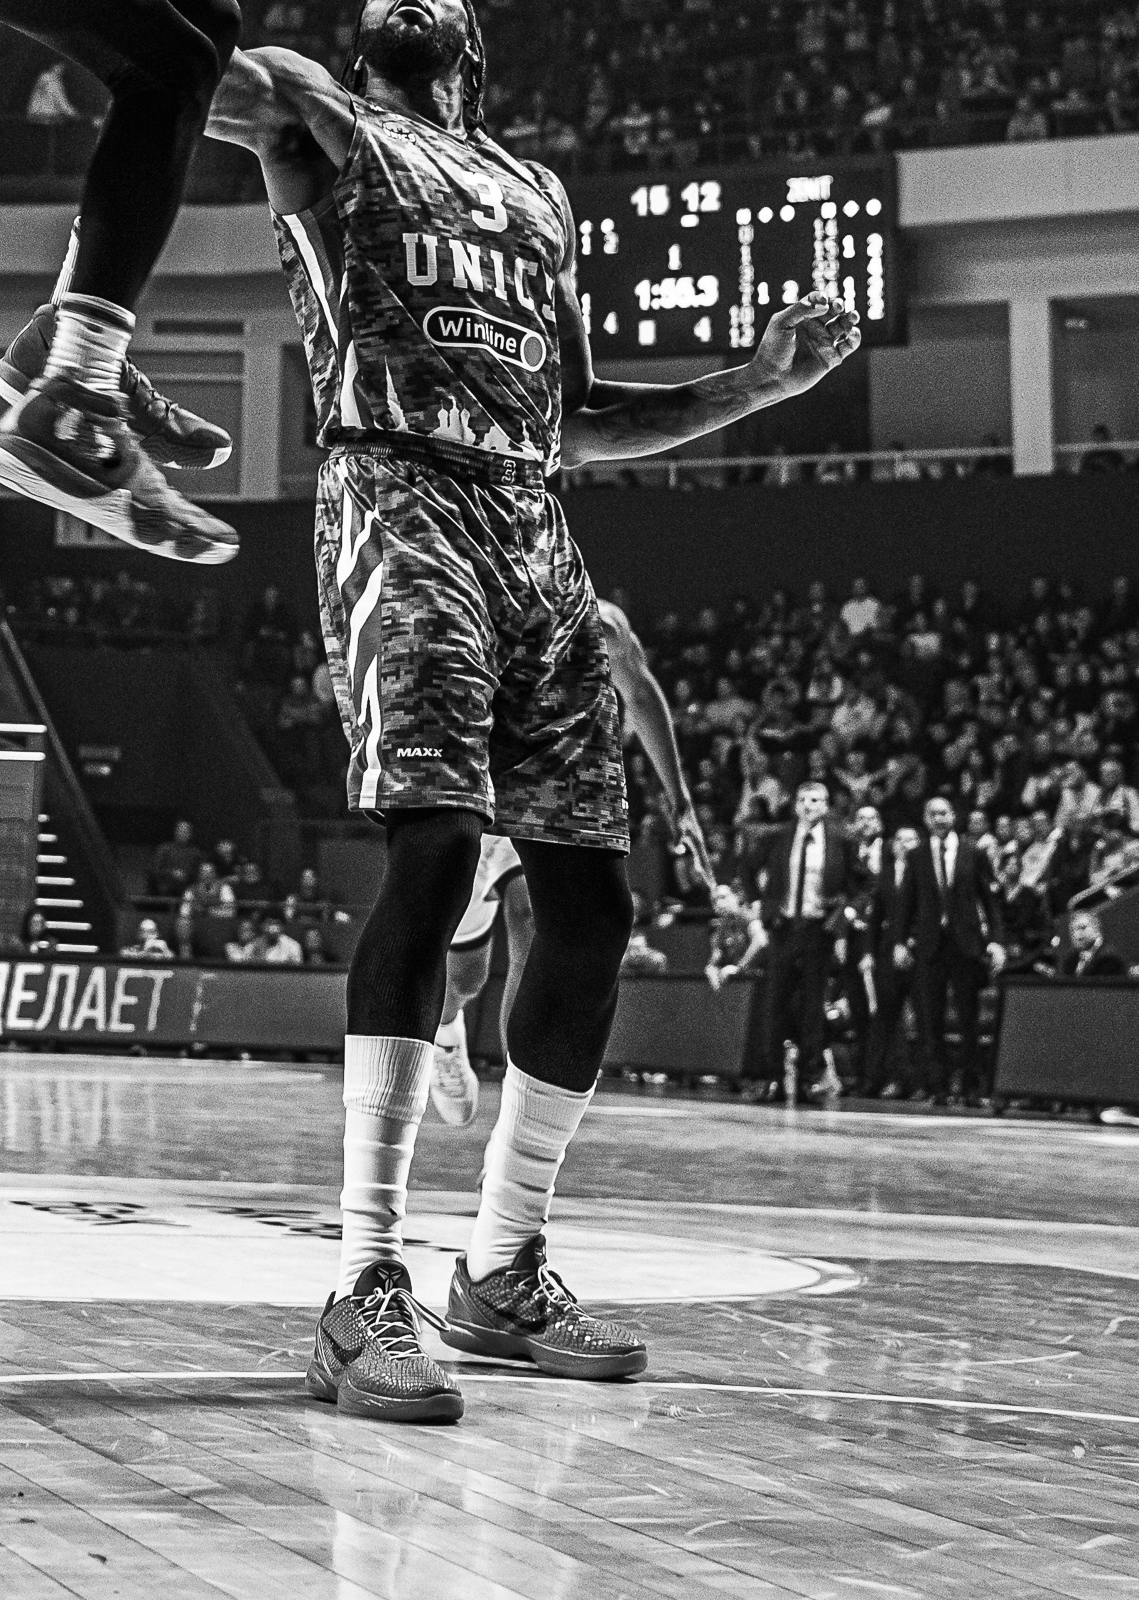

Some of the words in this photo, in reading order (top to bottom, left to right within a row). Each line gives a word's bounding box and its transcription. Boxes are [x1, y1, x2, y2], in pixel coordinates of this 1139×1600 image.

[461, 169, 508, 233] 3
[438, 315, 518, 355] Winline
[396, 747, 444, 759] MAXX
